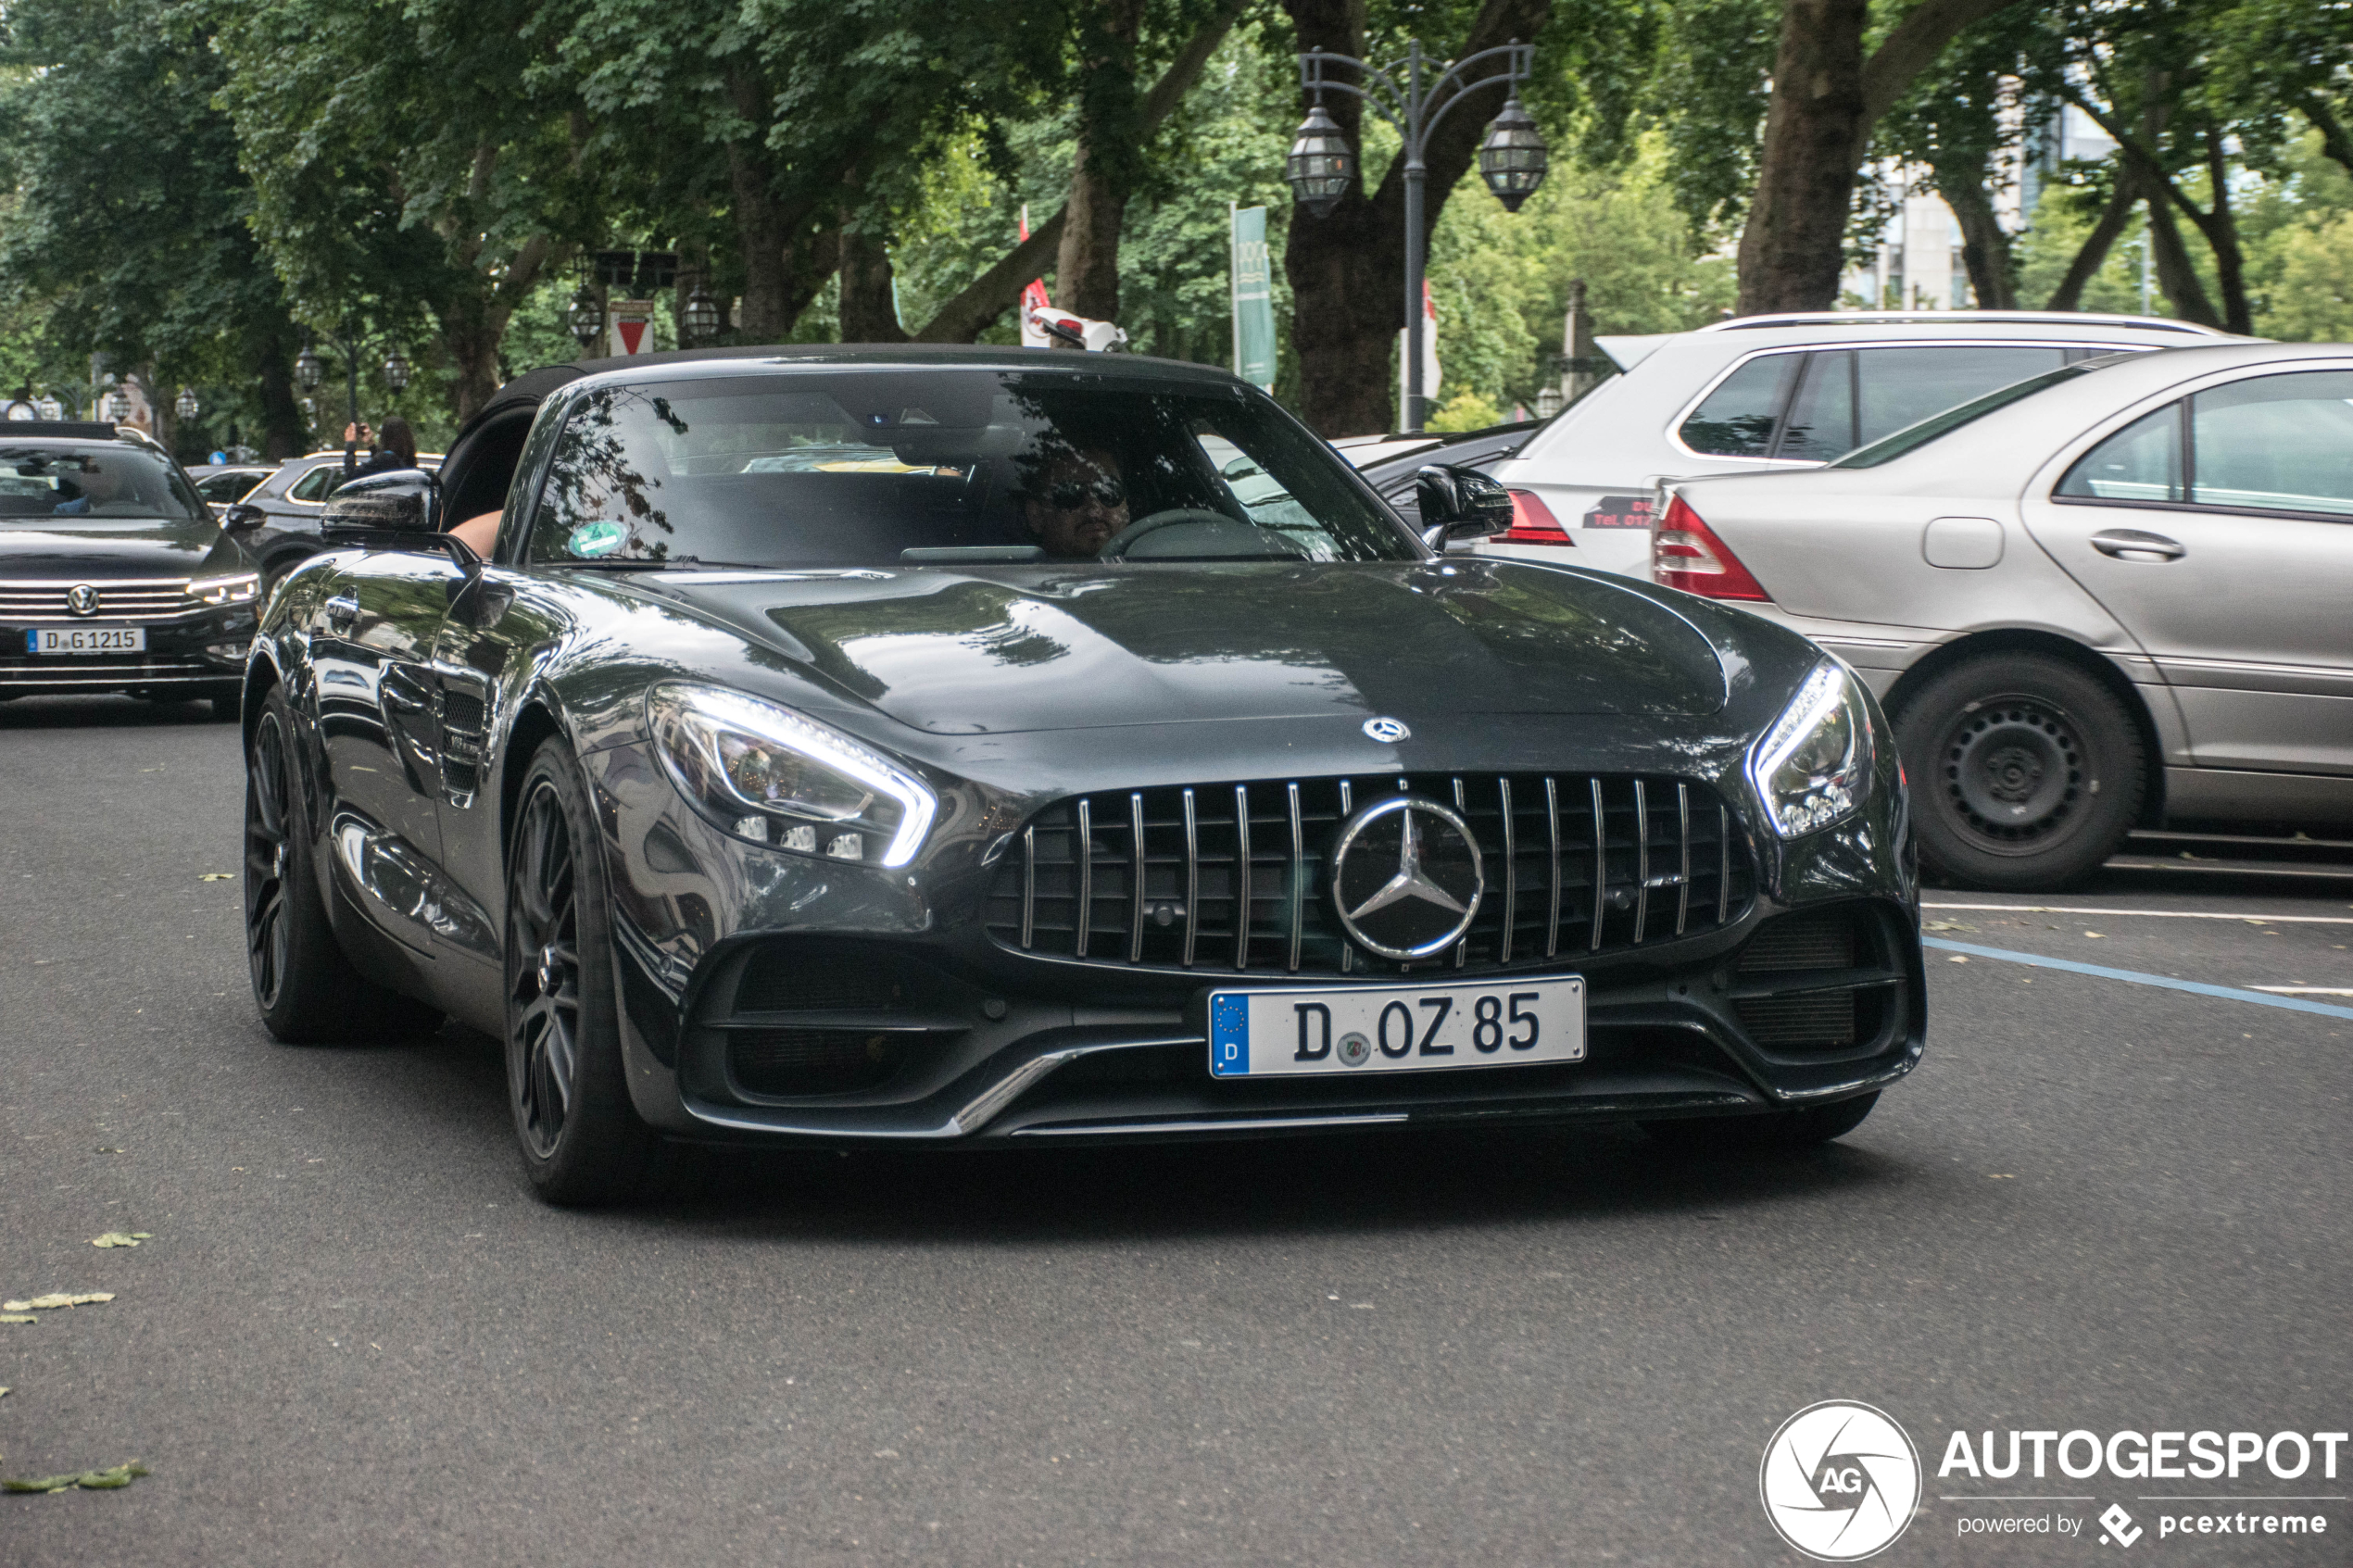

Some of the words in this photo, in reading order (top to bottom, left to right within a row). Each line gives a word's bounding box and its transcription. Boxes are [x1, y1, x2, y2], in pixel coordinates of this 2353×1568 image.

[1593, 514, 1620, 525] Tel.
[46, 632, 58, 649] D
[89, 631, 135, 649] 1215
[1293, 1002, 1331, 1062] D
[1378, 997, 1454, 1060] OZ
[1472, 992, 1540, 1054] 85
[1225, 1043, 1238, 1061] D
